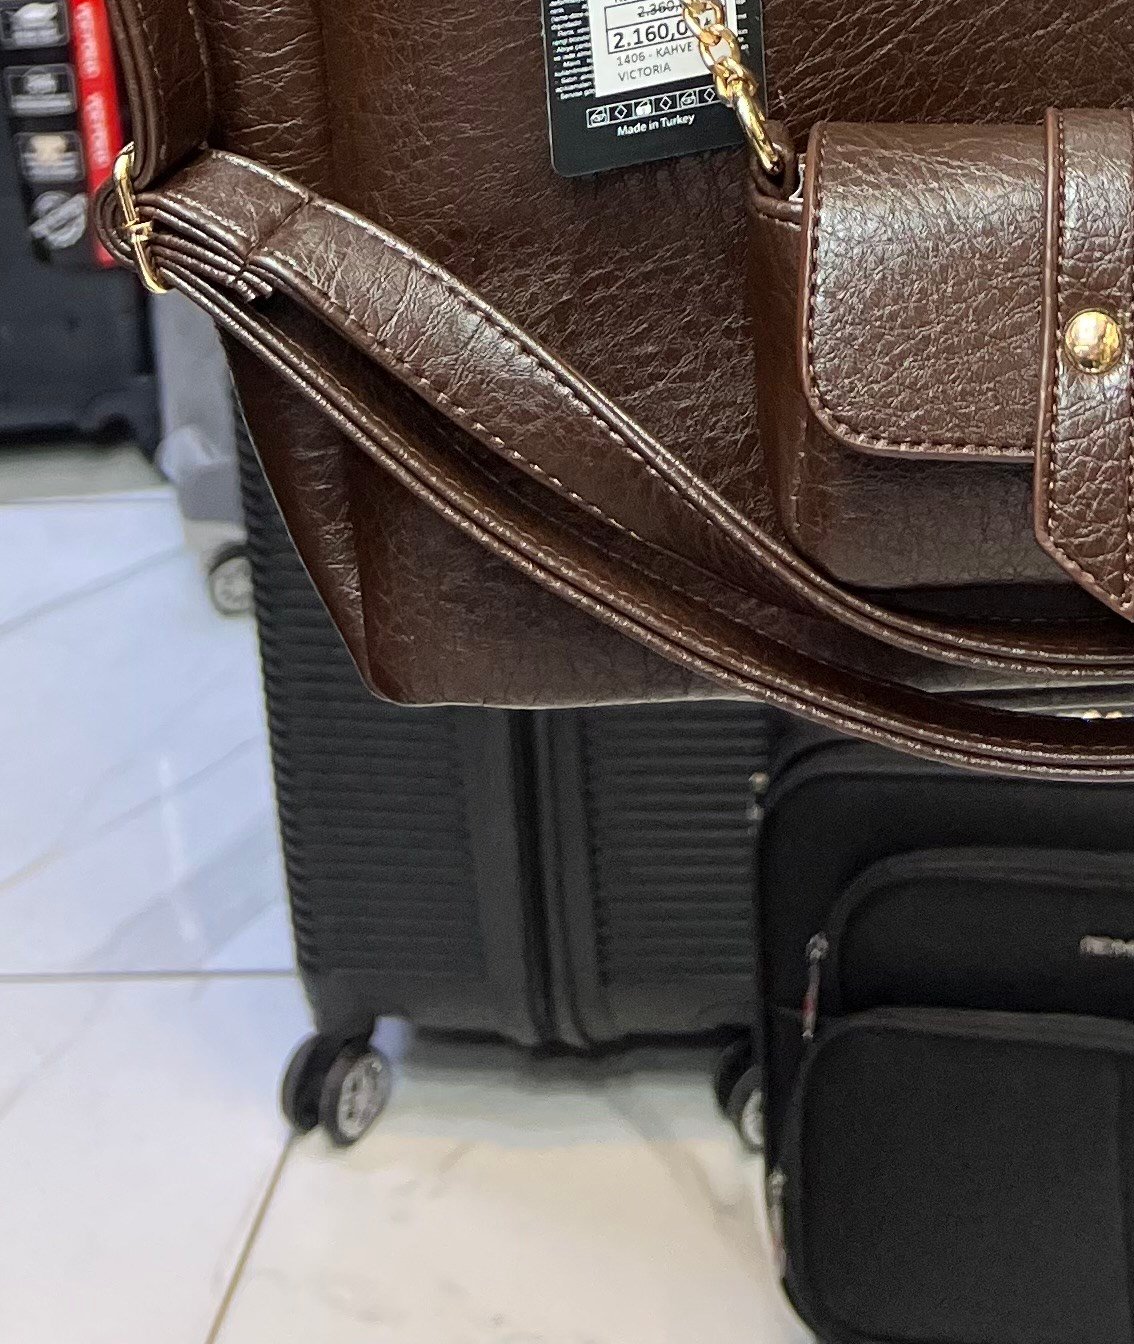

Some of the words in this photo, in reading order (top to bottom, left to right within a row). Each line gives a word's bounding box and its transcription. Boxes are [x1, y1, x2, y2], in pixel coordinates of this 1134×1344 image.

[656, 41, 693, 58] KAHVE
[618, 62, 672, 82] VICTORIA
[616, 122, 647, 137] Made
[648, 119, 660, 132] in
[659, 113, 695, 128] Turkey
